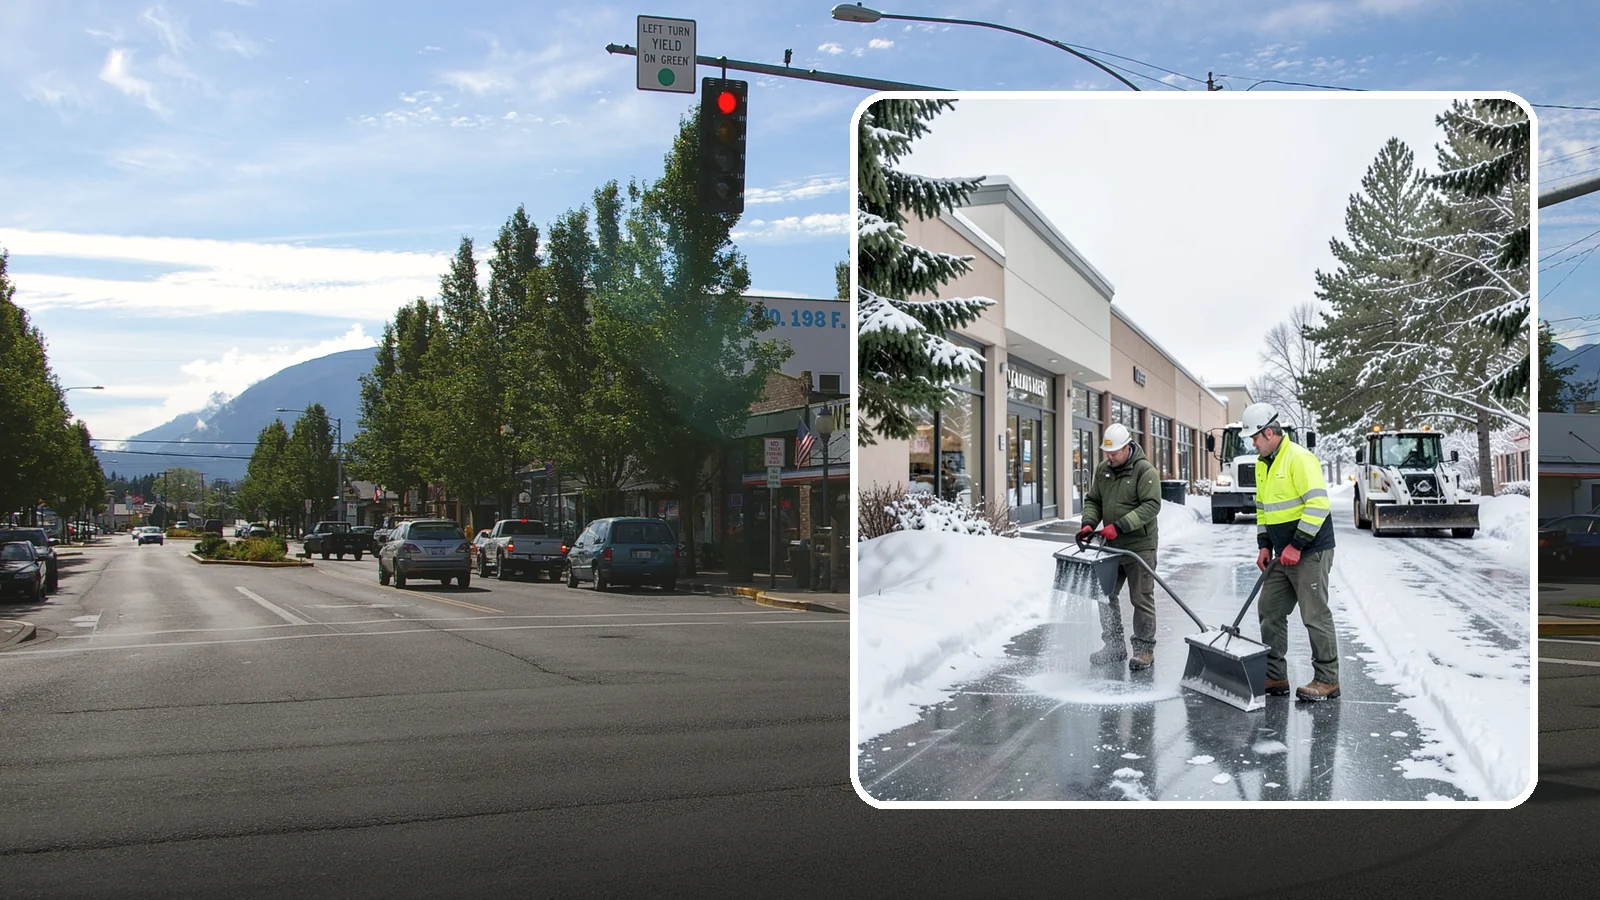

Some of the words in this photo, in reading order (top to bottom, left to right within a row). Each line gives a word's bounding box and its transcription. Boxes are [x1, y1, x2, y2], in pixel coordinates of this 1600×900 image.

[643, 24, 663, 34] LEFT
[668, 26, 690, 36] TURN
[652, 38, 682, 51] YIELD
[644, 53, 656, 64] ON
[661, 55, 688, 66] GREEN
[791, 309, 826, 328] 198
[831, 311, 847, 329] F.
